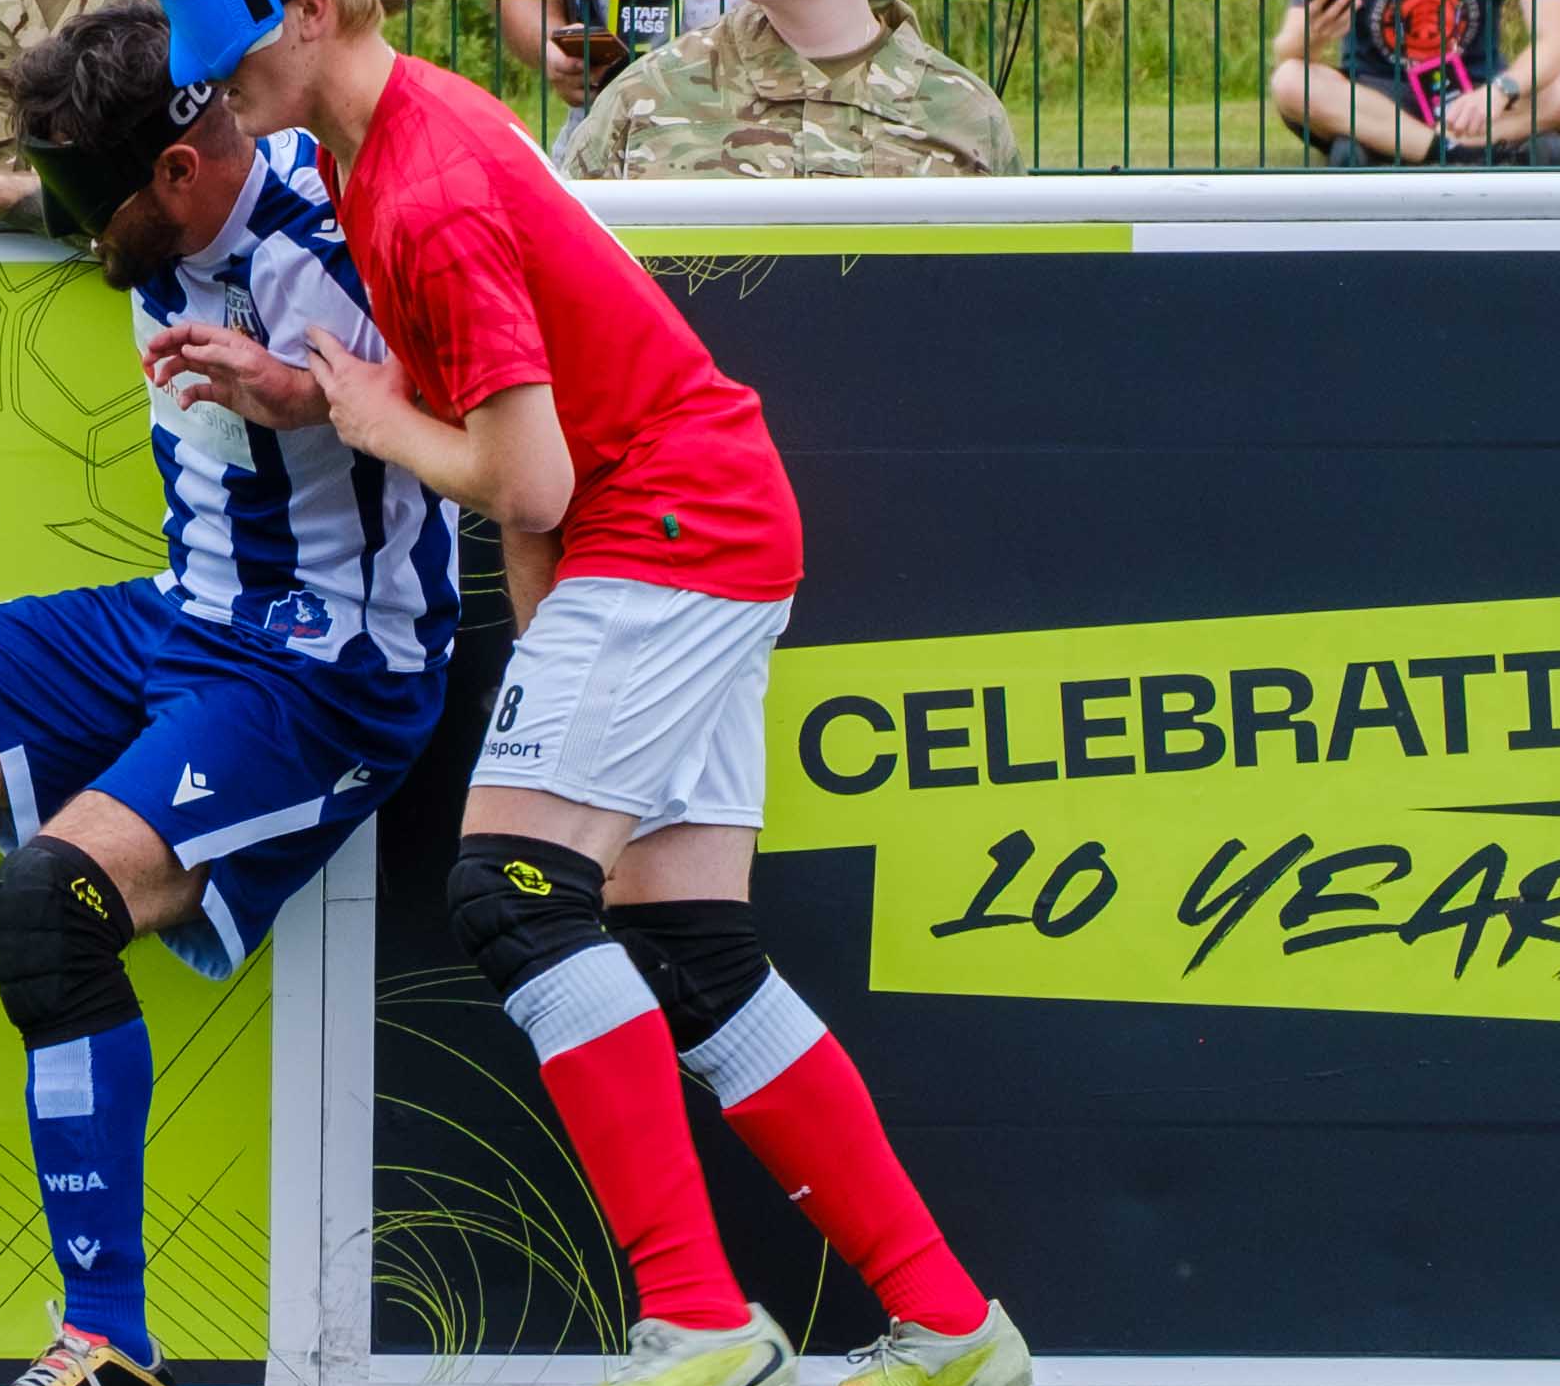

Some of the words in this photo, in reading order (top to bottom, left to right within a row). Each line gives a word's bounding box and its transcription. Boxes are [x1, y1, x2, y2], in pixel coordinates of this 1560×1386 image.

[621, 6, 669, 19] STAFF
[623, 20, 665, 33] PASS
[496, 685, 523, 733] 8
[930, 829, 1118, 939] 10
[44, 1171, 108, 1192] WBA
